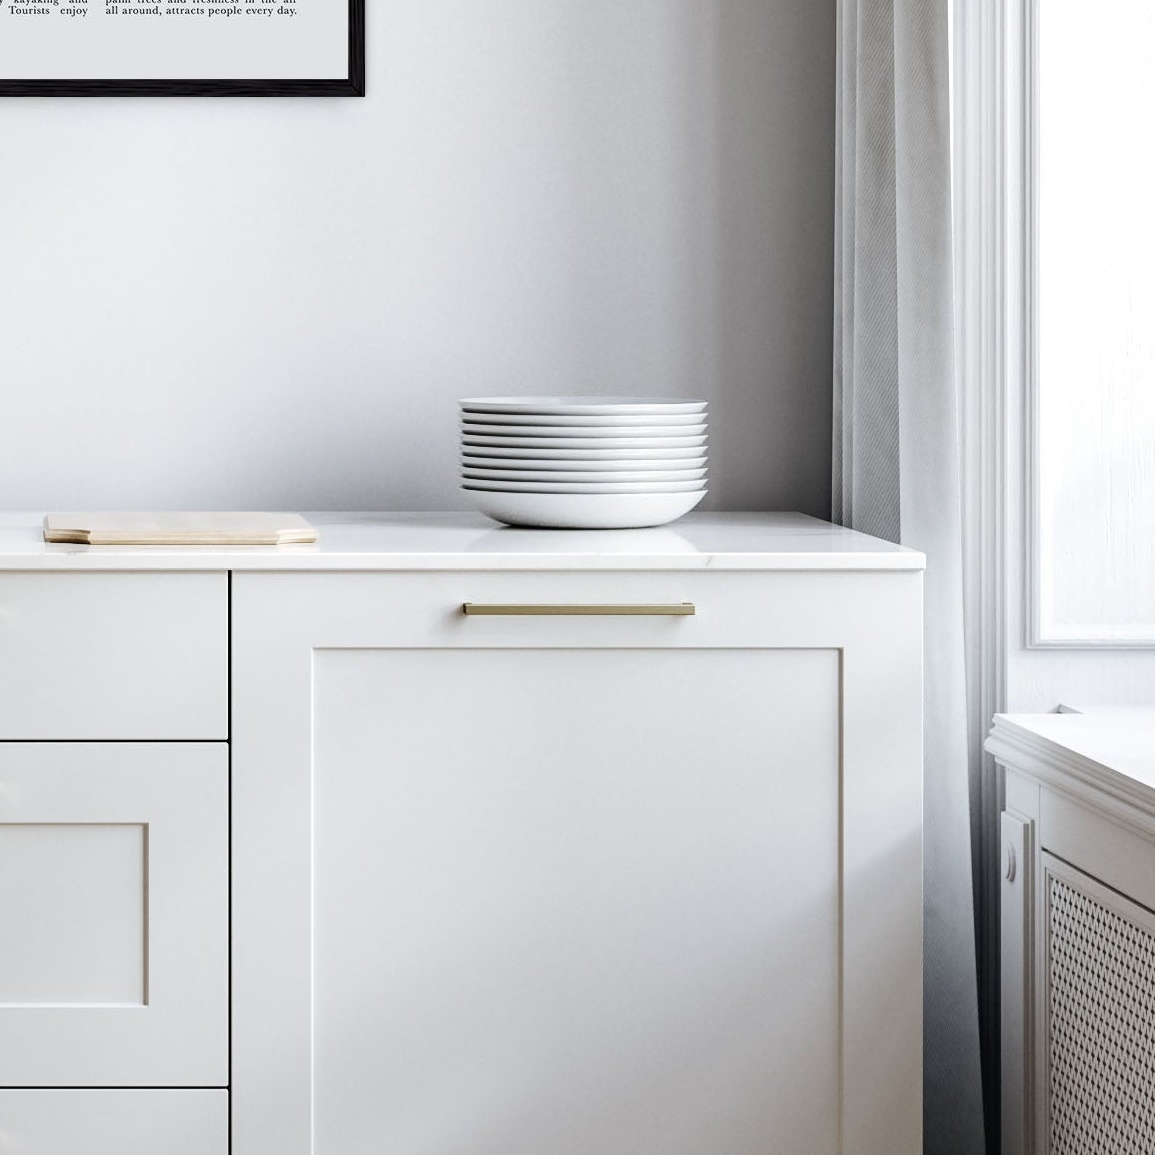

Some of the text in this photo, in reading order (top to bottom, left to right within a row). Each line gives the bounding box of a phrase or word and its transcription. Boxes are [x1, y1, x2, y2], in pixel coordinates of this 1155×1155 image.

[9, 5, 50, 15] Tourists
[60, 5, 88, 17] enjoy
[105, 5, 297, 17] all around, attracts people every day.
